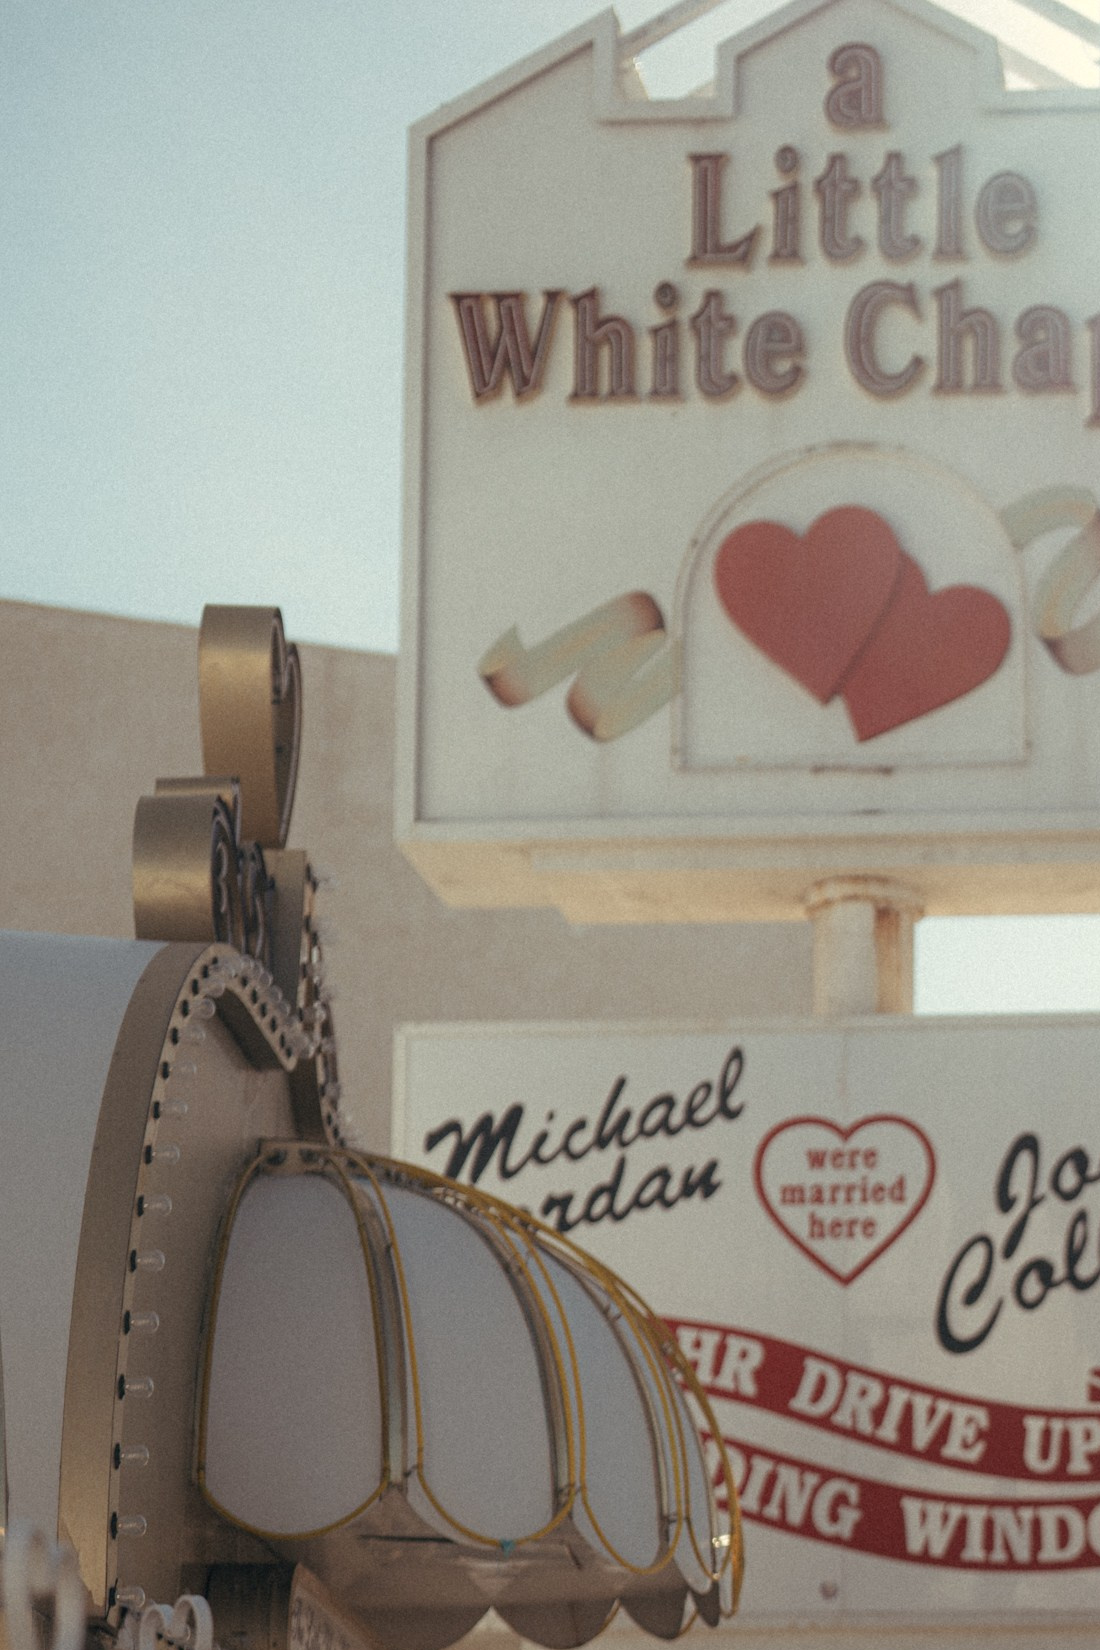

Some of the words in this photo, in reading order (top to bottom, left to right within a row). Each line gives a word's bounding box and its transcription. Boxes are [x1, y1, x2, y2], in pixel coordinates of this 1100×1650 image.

[824, 42, 890, 130] a
[686, 145, 1041, 270] Little
[446, 281, 808, 404] White
[424, 1045, 746, 1185] Michael
[806, 1147, 878, 1171] were
[537, 1154, 724, 1234] rdan
[779, 1174, 906, 1205] married
[808, 1212, 876, 1240] here
[789, 1356, 989, 1464] DRIVE
[704, 1440, 864, 1542] DING
